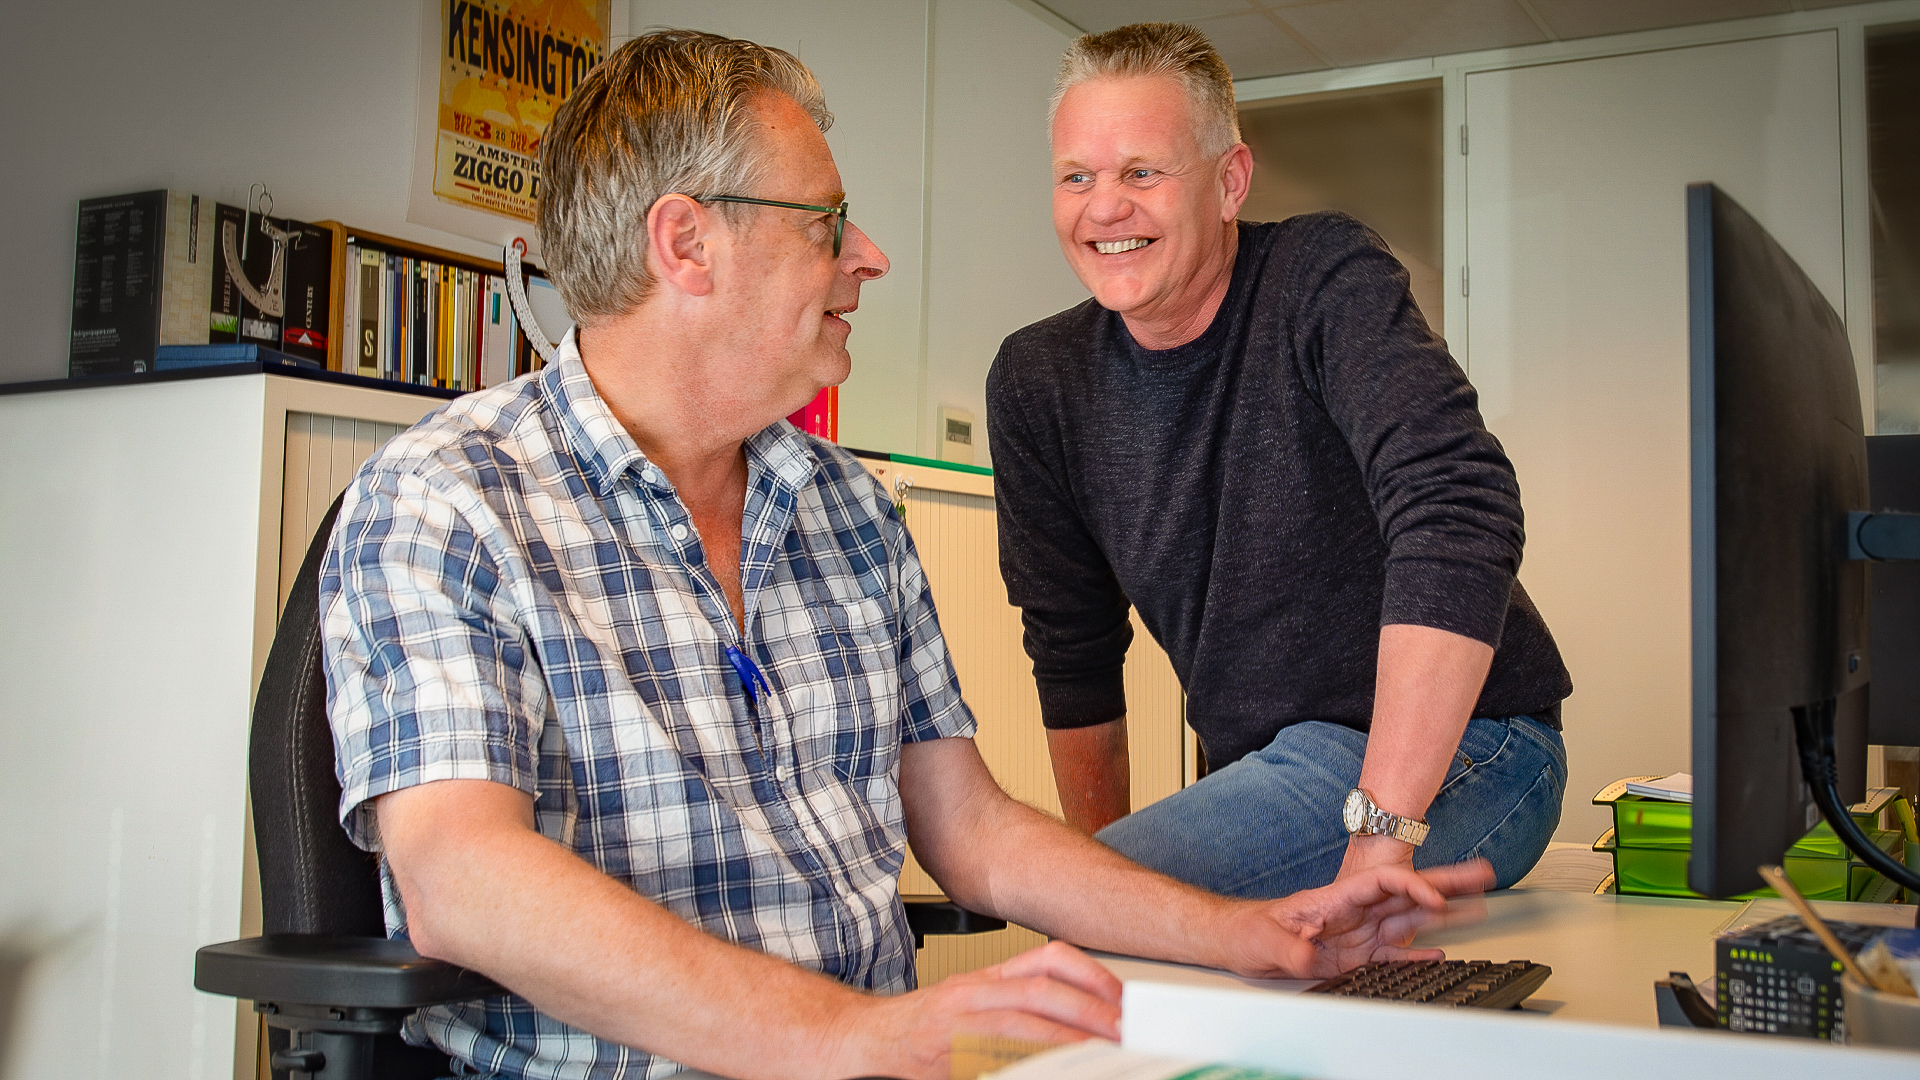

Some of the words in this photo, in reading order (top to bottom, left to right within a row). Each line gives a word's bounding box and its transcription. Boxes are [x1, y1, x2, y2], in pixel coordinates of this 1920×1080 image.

[474, 119, 492, 140] 3
[453, 151, 524, 194] ZIGGO
[305, 284, 314, 329] CENTURY
[364, 328, 374, 357] S
[1729, 948, 1774, 964] APRIL
